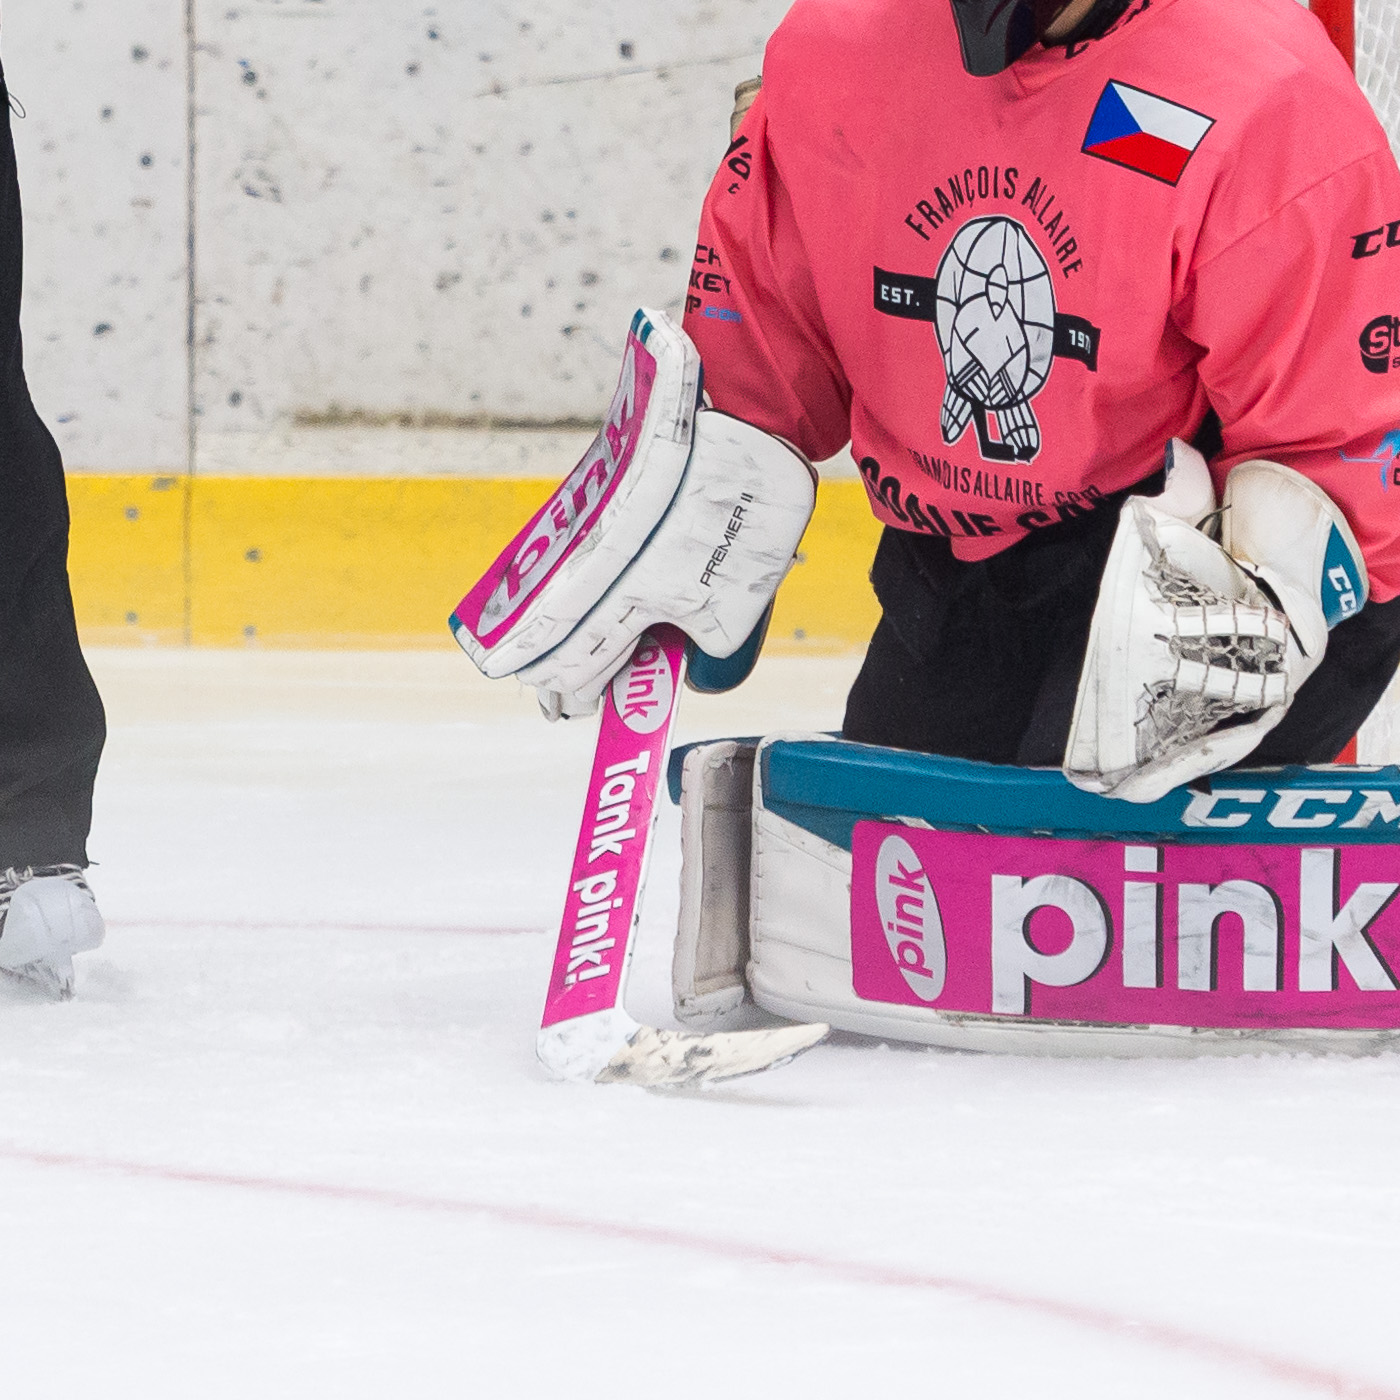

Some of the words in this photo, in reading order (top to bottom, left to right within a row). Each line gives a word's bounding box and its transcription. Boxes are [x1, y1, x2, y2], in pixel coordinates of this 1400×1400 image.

[904, 165, 1019, 241] FRANÇOIS
[1021, 176, 1084, 279] ALLAIRE
[880, 283, 920, 307] EST.
[498, 393, 638, 603] pink
[700, 503, 749, 588] PREMIER
[740, 491, 756, 506] II
[587, 750, 651, 865] Tank
[563, 868, 624, 988] pink!
[886, 859, 935, 980] pink
